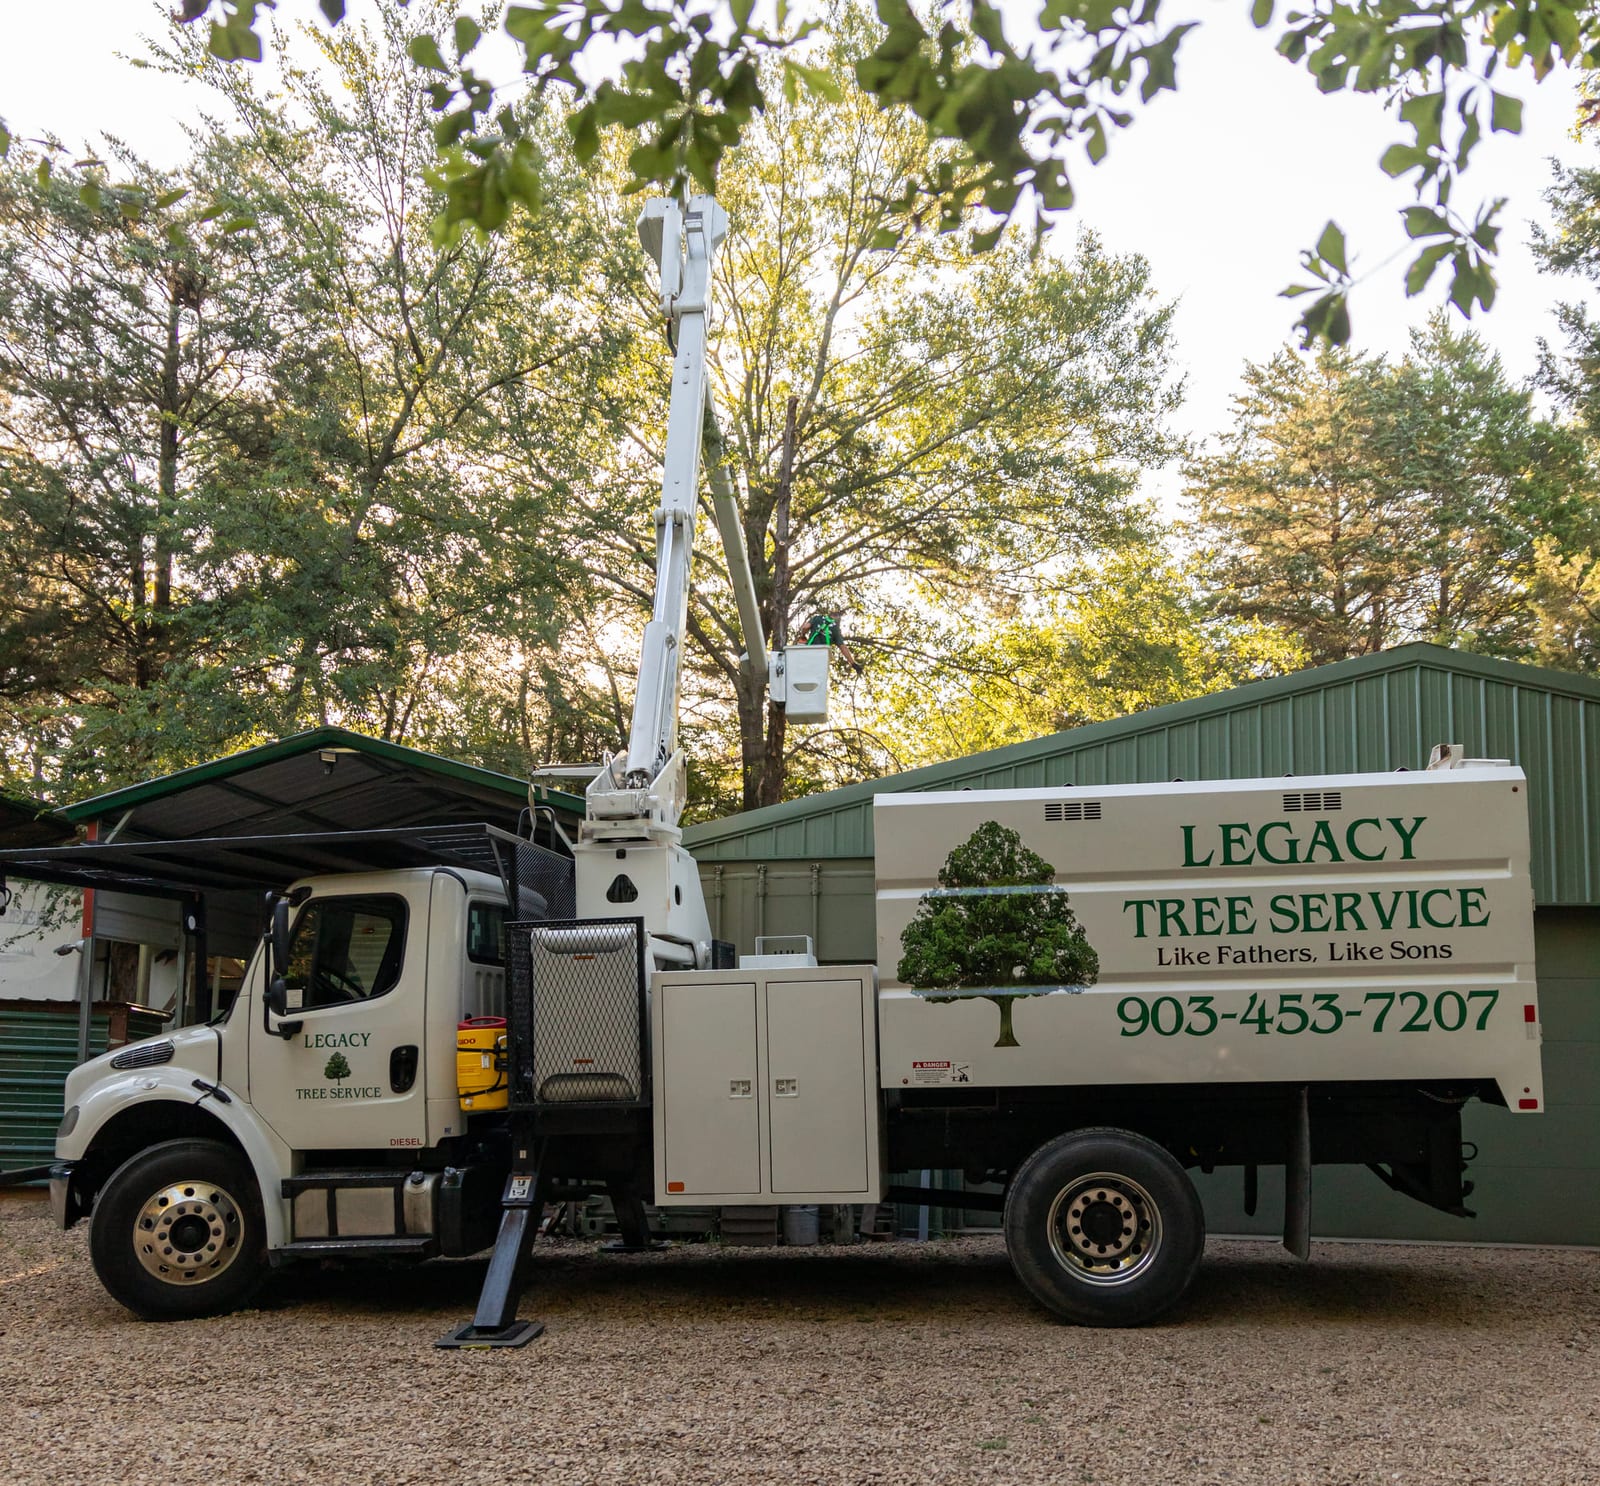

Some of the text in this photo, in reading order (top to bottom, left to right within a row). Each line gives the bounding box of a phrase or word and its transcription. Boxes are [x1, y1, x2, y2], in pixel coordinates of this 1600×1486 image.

[1180, 816, 1427, 867] LEGACY
[1123, 887, 1491, 938] TREE SERVICE
[1157, 940, 1453, 966] Like Fathers, Like Sons
[1116, 989, 1500, 1037] 903-453-7207
[304, 1033, 372, 1048] LEGACY
[296, 1087, 382, 1100] TREE SERVICE
[390, 1138, 423, 1146] DIESEL
